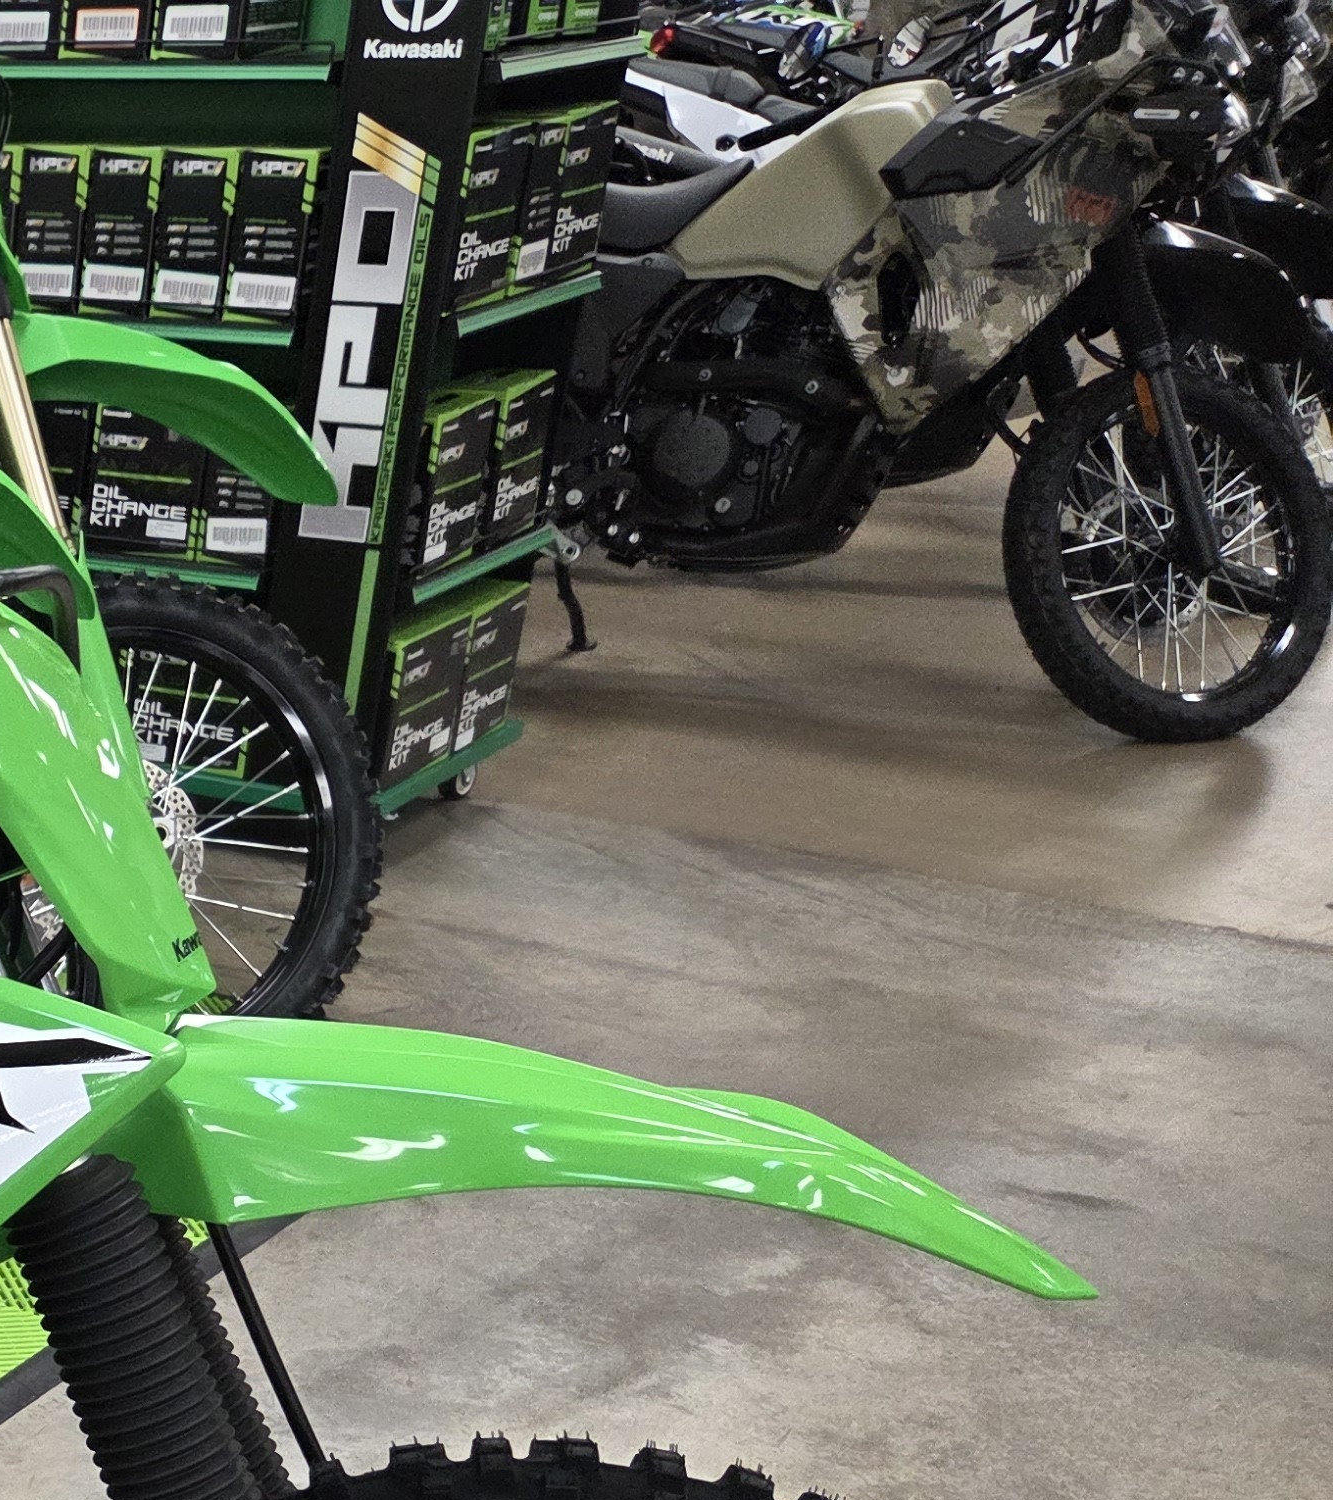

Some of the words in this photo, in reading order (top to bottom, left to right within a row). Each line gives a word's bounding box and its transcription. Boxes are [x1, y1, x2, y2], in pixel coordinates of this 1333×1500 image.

[362, 37, 464, 60] Kawasaki
[553, 212, 600, 239] CHANGE
[456, 237, 511, 265] CHANGE
[459, 230, 482, 249] OIL
[551, 236, 573, 255] KIT
[453, 262, 479, 282] KIT
[370, 440, 396, 543] KAWASAKI
[386, 272, 422, 437] PERFORMANCE
[413, 212, 432, 265] OILS
[92, 482, 130, 501] OIL
[89, 512, 127, 528] KIT
[90, 497, 187, 520] CHANGE
[133, 713, 235, 742] CHANGE
[391, 716, 445, 756] CHANGE
[457, 714, 478, 735] KIT
[388, 748, 411, 771] KIT
